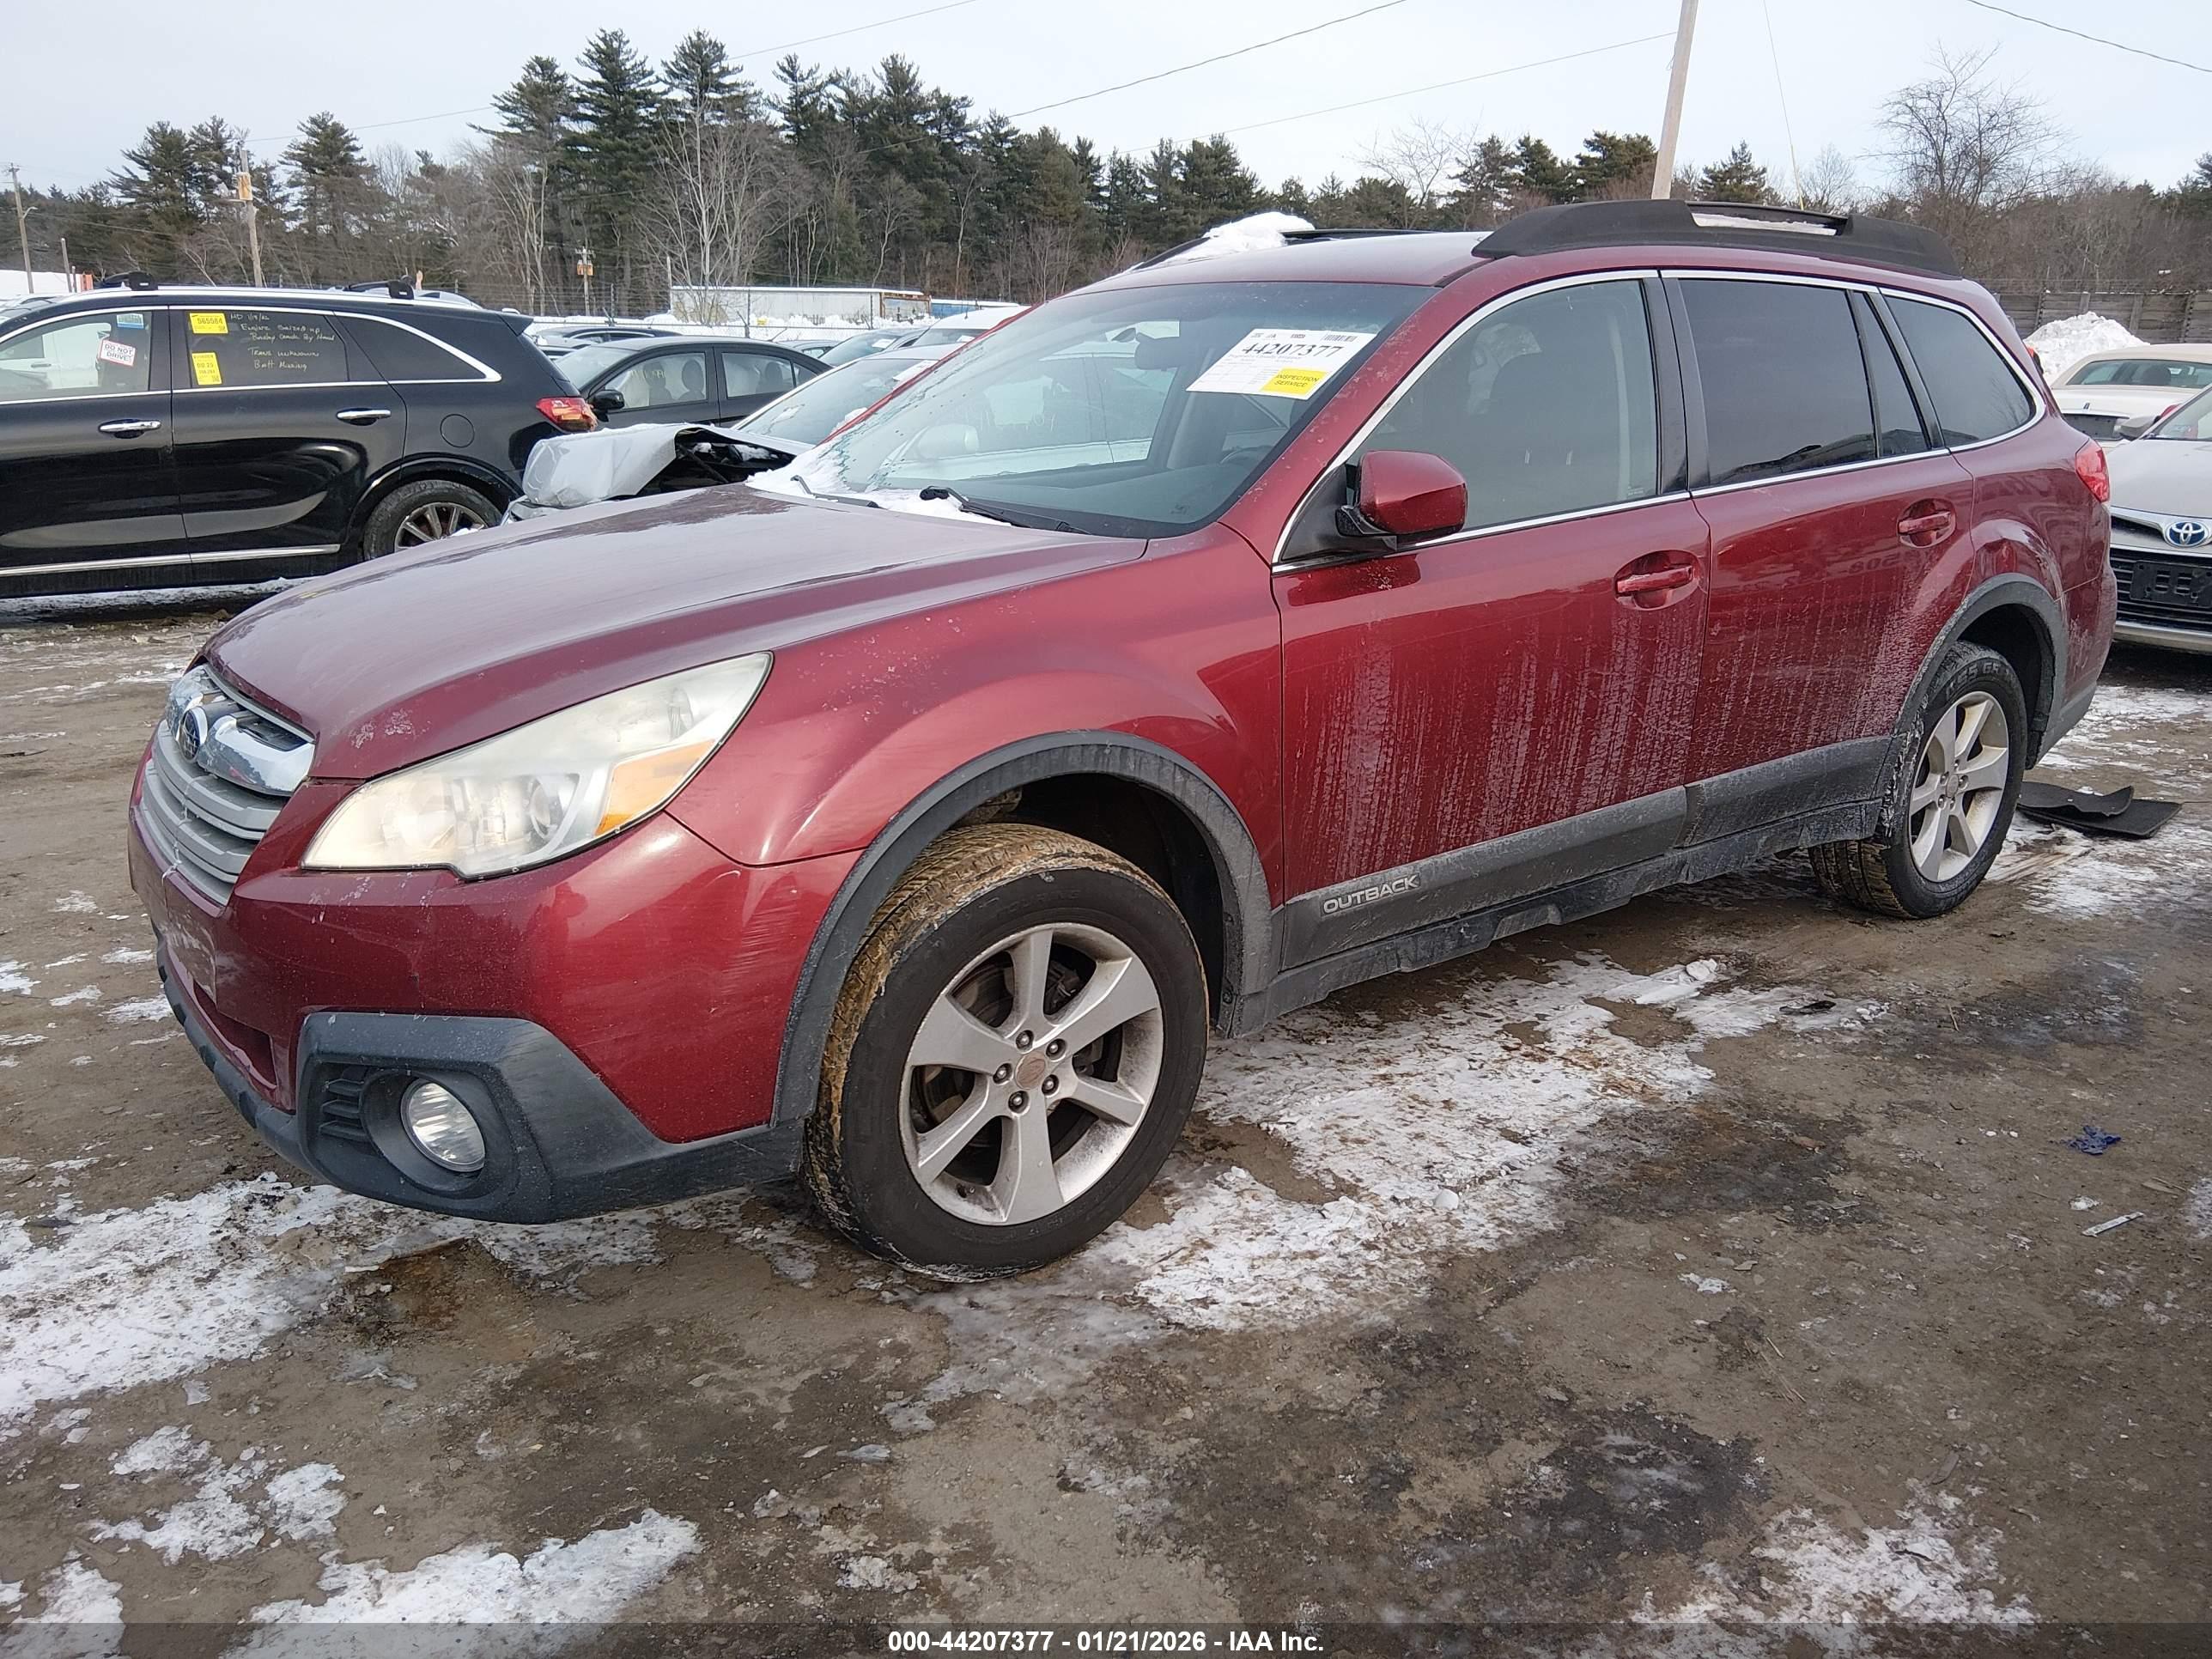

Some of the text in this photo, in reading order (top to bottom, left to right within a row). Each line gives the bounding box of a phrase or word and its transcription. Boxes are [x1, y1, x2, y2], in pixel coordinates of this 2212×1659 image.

[106, 351, 129, 361] DRIVE
[1242, 343, 1344, 357] 44207377
[1275, 373, 1321, 383] INSPECTION
[1323, 875, 1419, 914] OUTBACK
